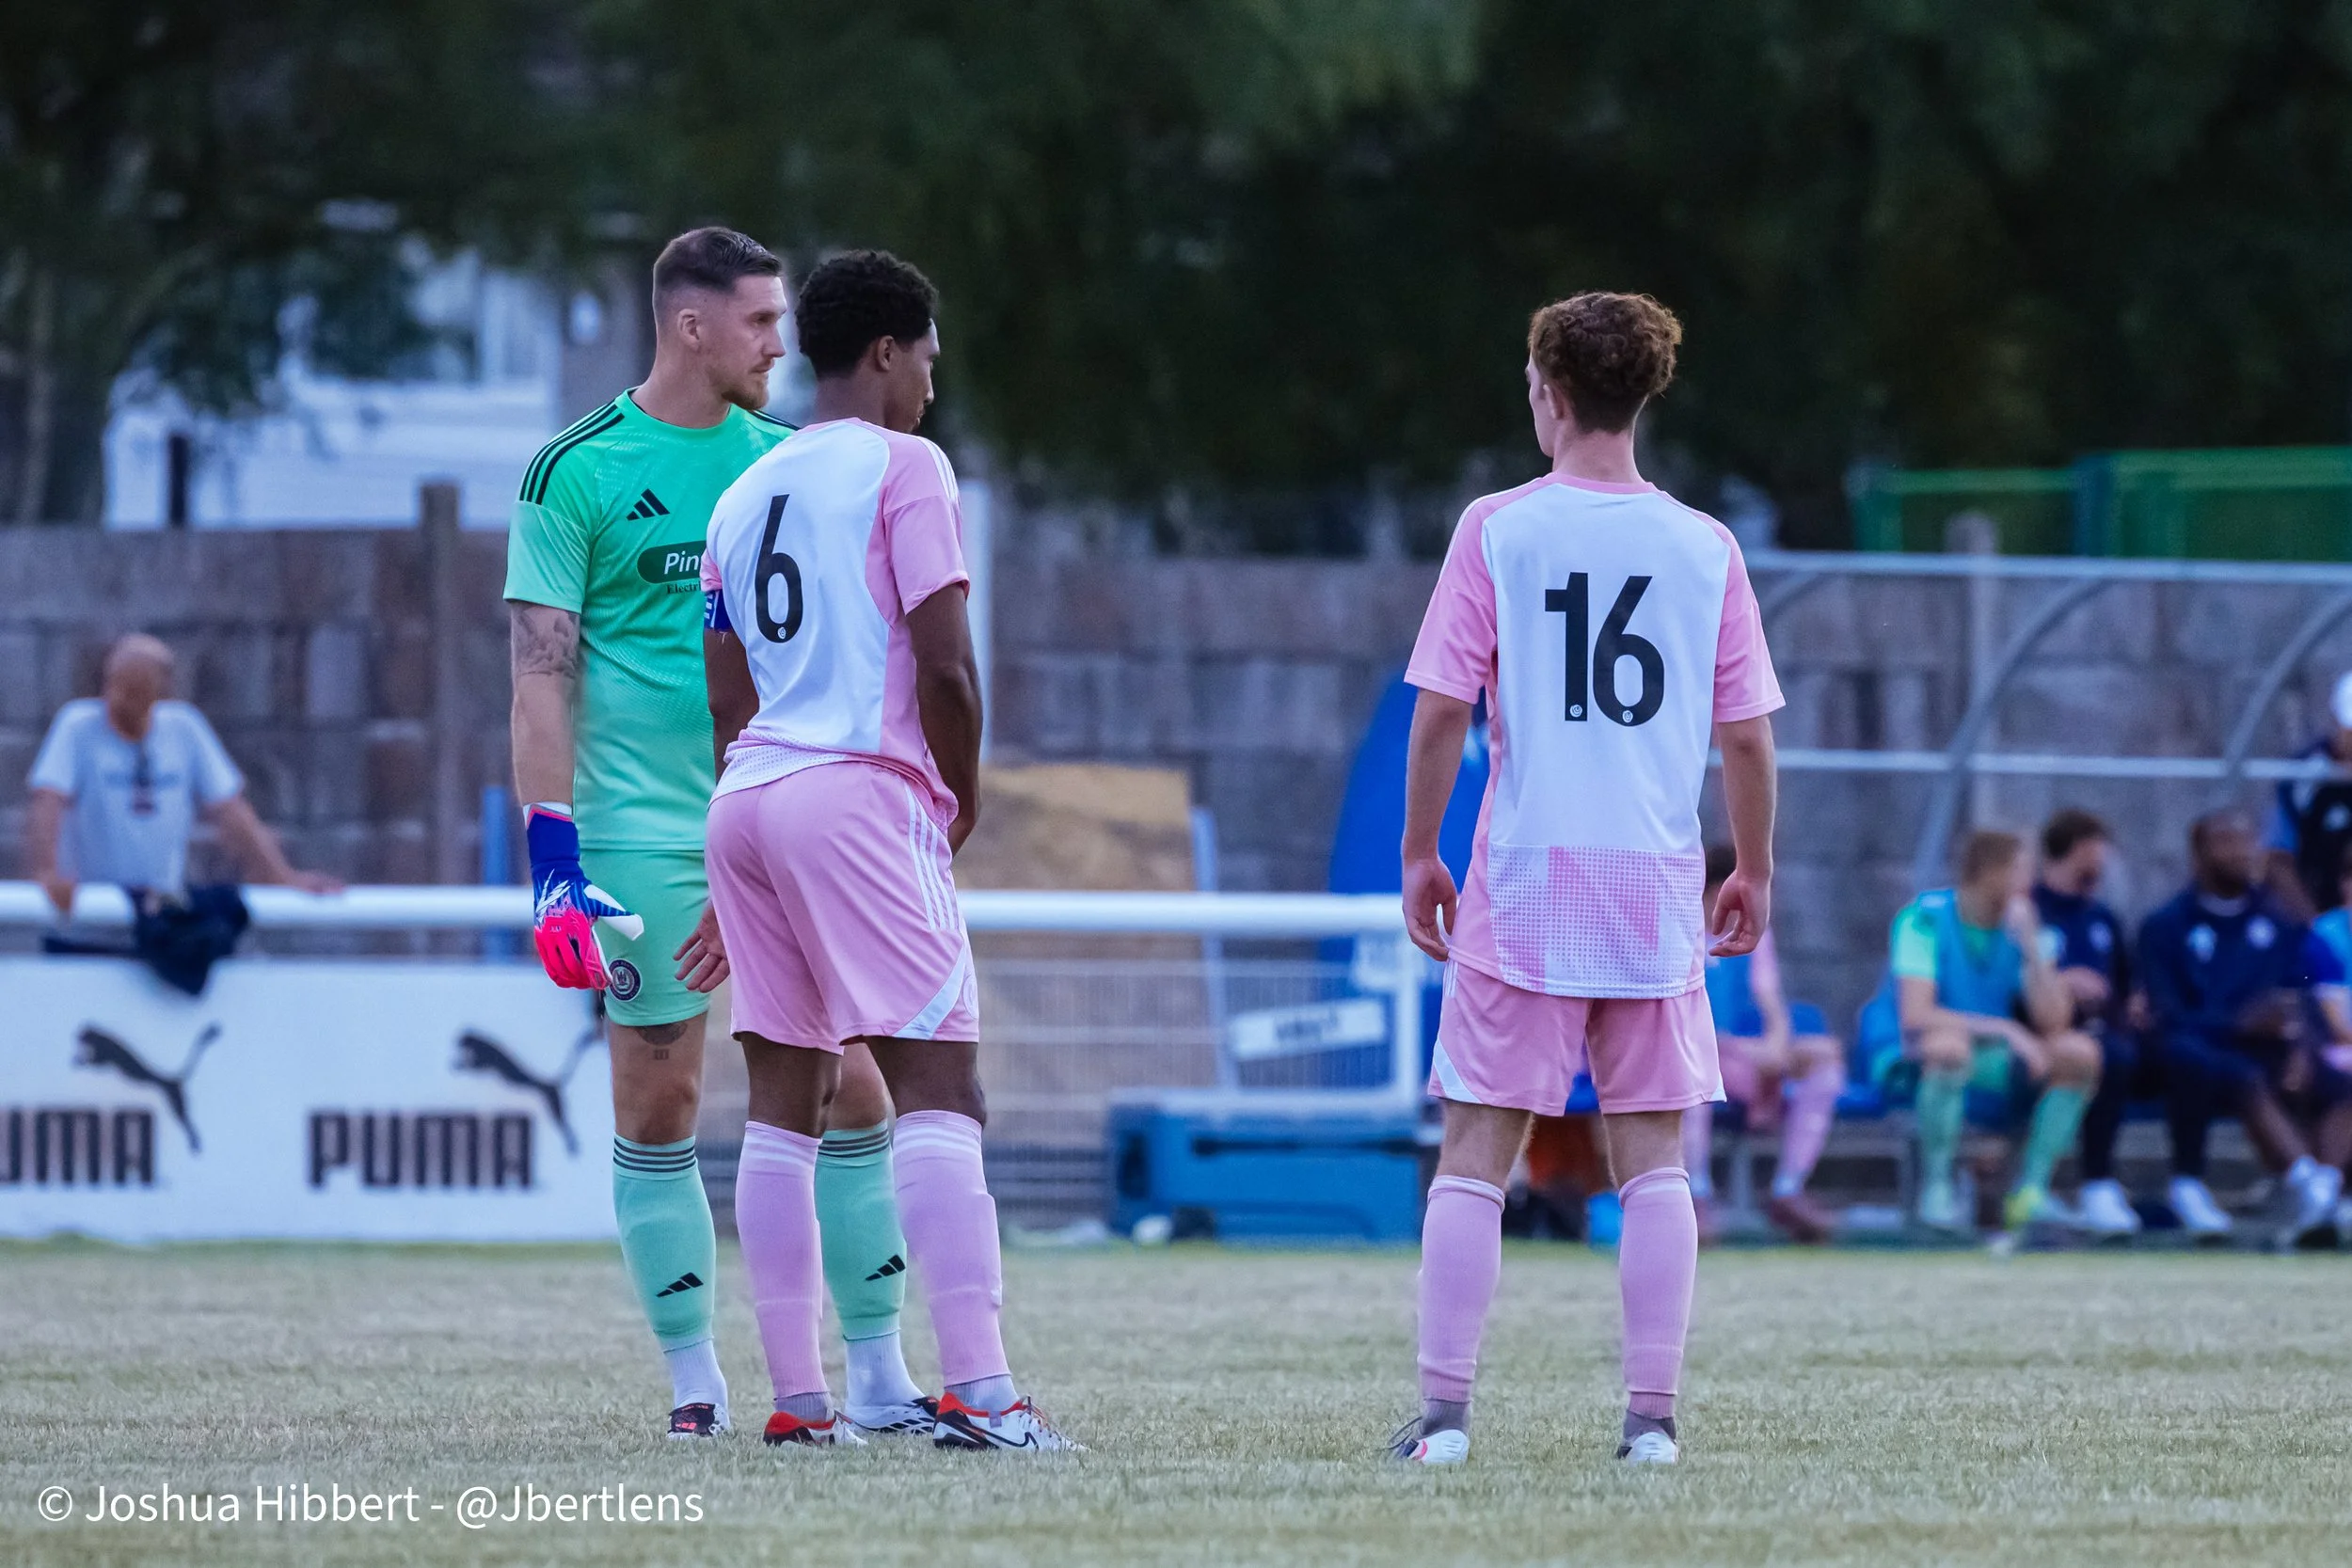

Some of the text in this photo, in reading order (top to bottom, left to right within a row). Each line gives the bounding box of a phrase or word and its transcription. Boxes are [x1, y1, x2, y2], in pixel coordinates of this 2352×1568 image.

[664, 550, 700, 575] Pin
[754, 493, 803, 643] 6
[1544, 571, 1665, 727] 16
[308, 1110, 535, 1191] PUMA
